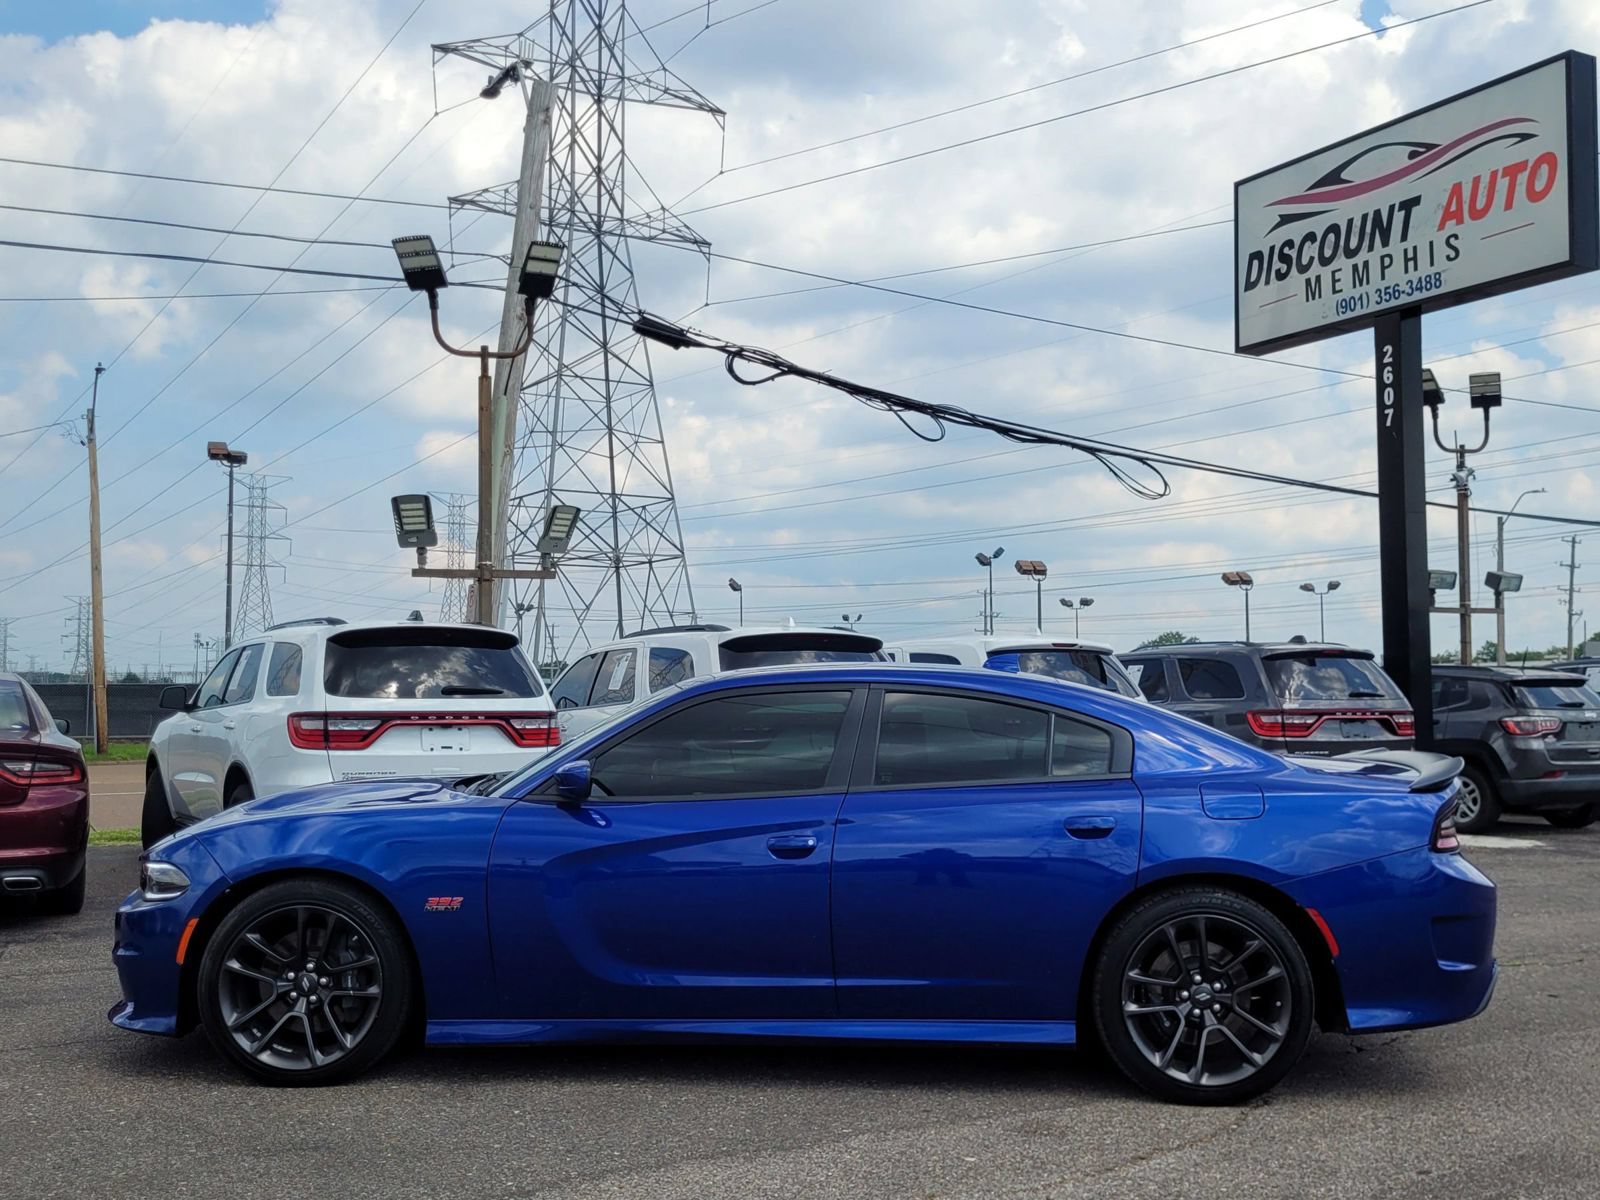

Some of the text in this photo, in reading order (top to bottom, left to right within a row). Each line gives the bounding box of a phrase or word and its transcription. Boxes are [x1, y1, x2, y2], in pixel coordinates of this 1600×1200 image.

[1243, 151, 1558, 293] DISCOUNT AUTO
[1305, 233, 1461, 303] MEMPHIS
[1335, 271, 1443, 317] (901) 356-3488
[1382, 344, 1395, 427] 2607
[425, 896, 465, 906] 392
